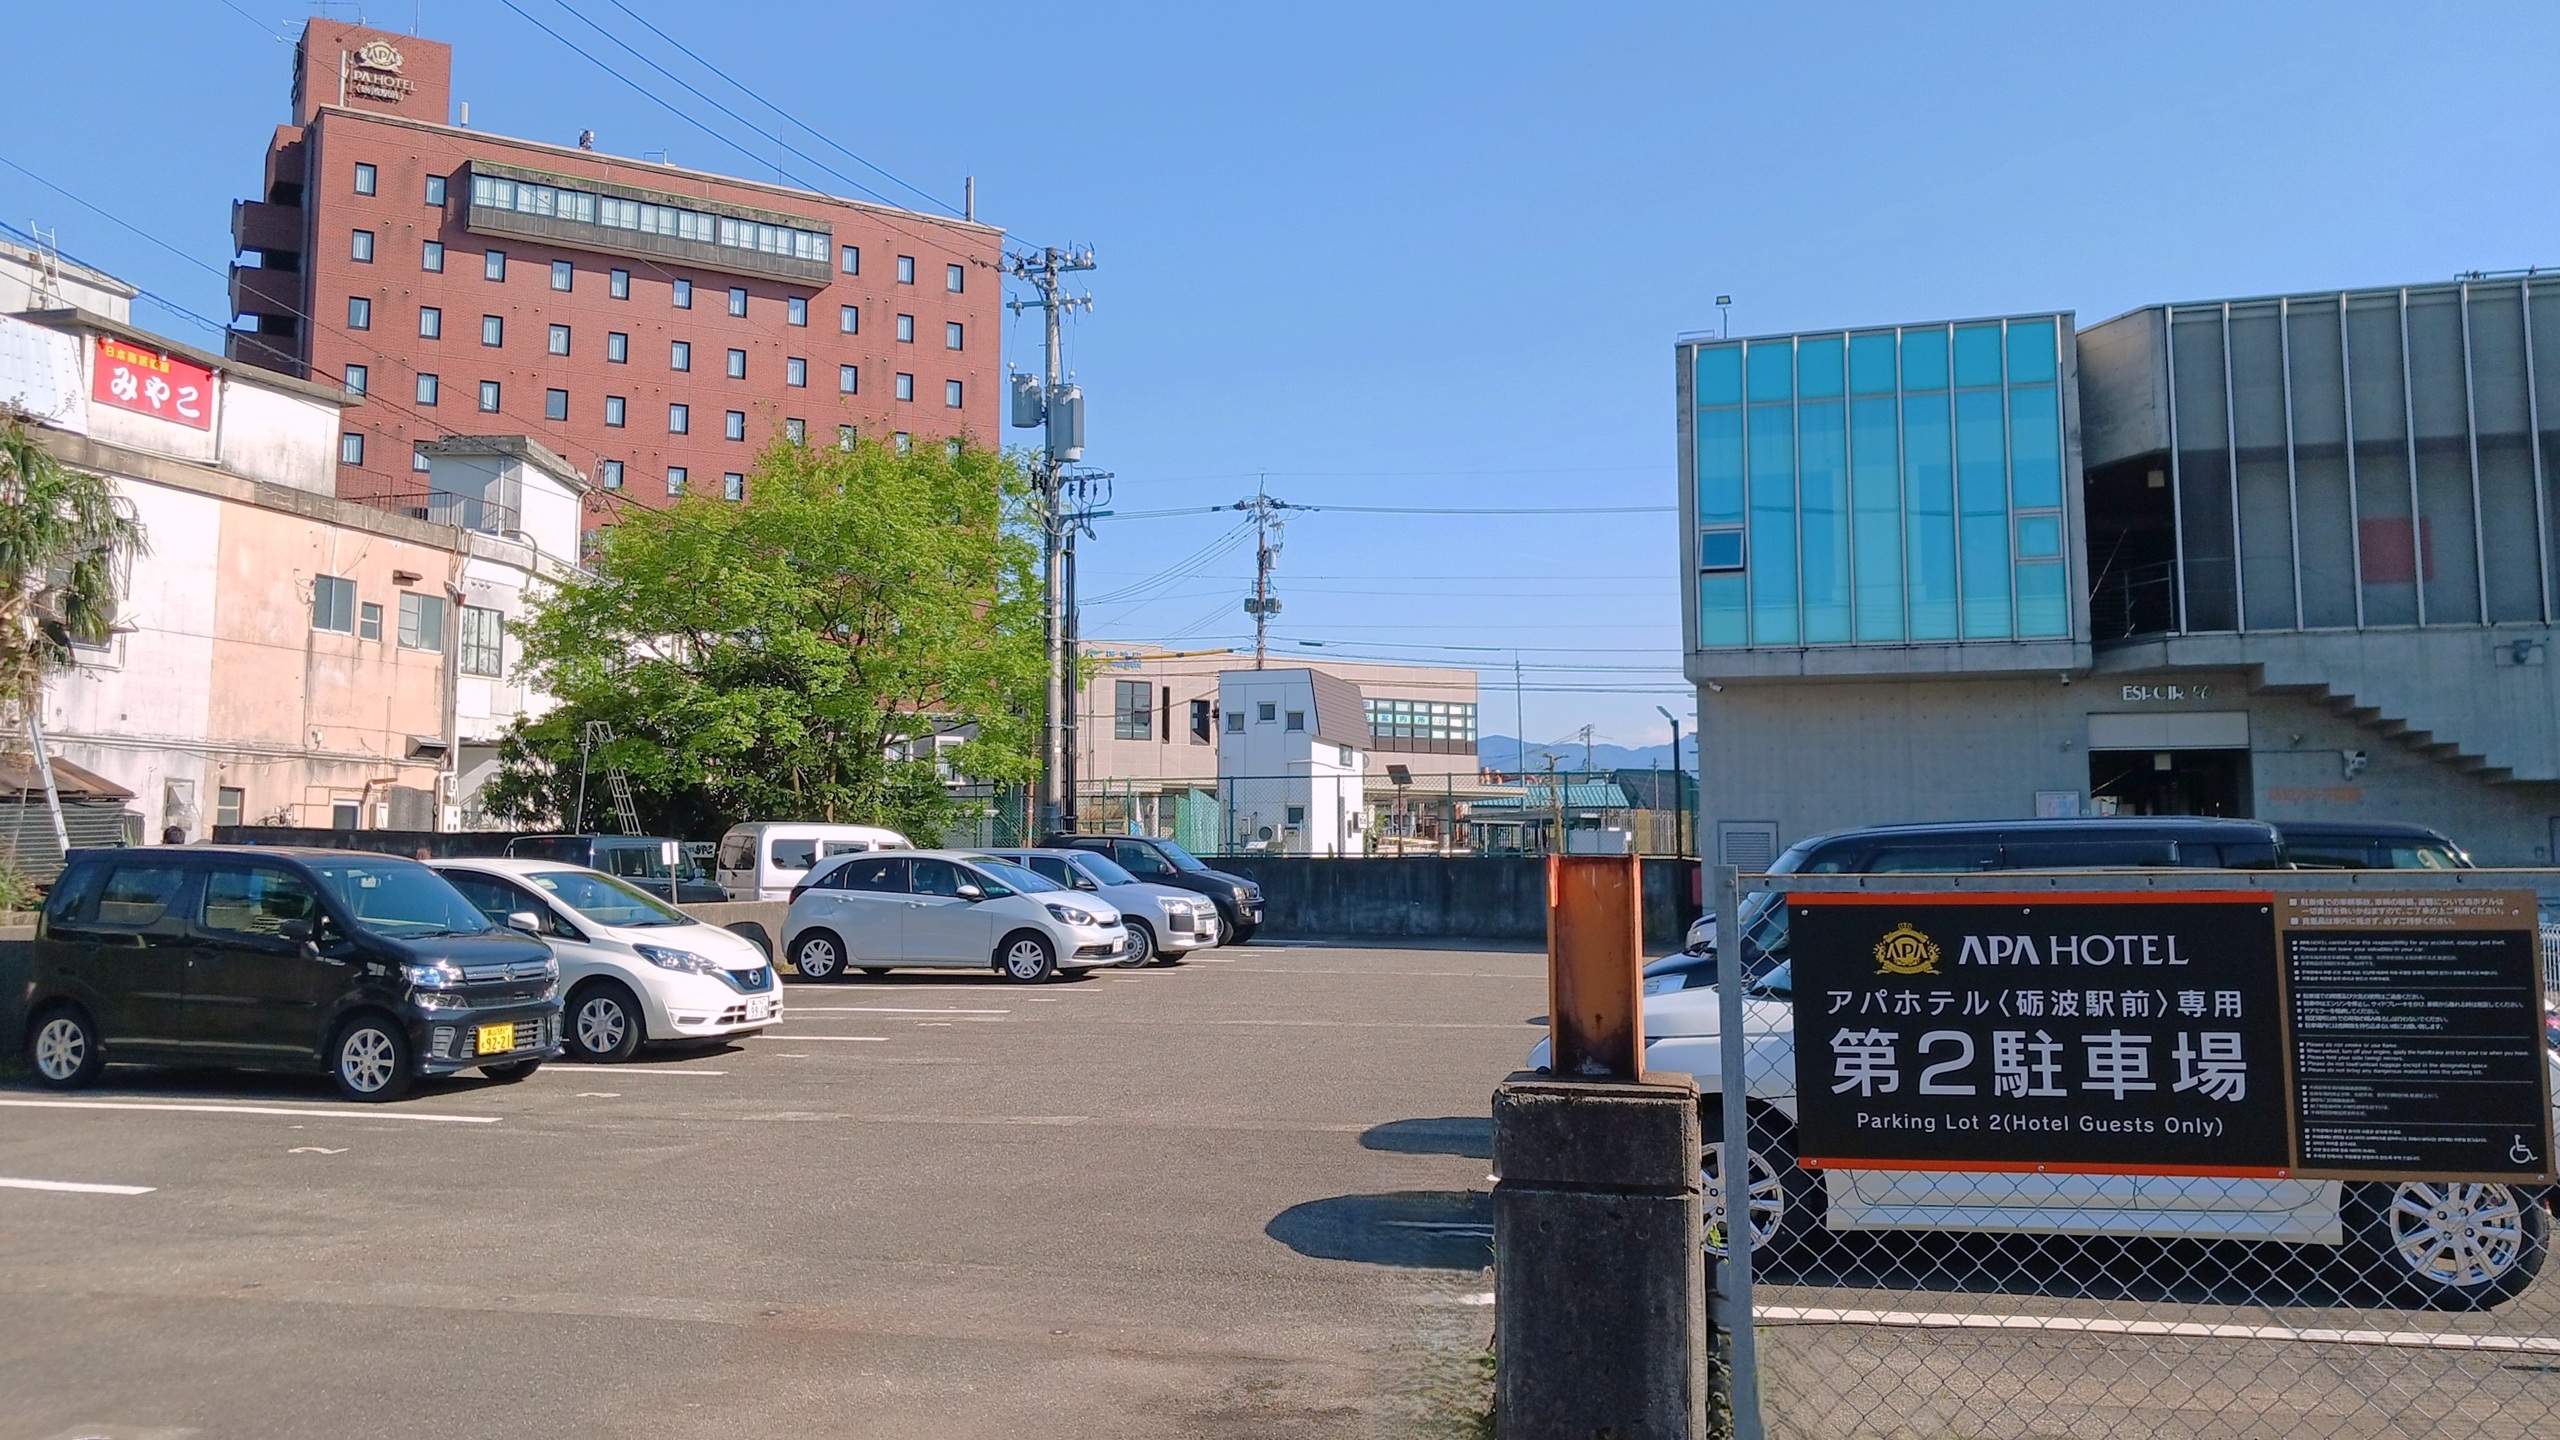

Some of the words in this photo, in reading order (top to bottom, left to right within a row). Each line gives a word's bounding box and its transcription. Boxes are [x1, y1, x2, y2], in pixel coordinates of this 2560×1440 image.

[374, 73, 418, 91] HOTEL
[110, 366, 200, 418] みやこ
[1885, 939, 1929, 961] APA
[1958, 935, 2041, 966] APA
[2050, 934, 2190, 967] HOTEL
[1828, 1026, 2248, 1102] 第2駐車場
[1857, 1112, 1937, 1133] Parking
[1945, 1114, 1979, 1131] Lot
[2079, 1115, 2155, 1133] Guests
[2164, 1117, 2224, 1138] Only)
